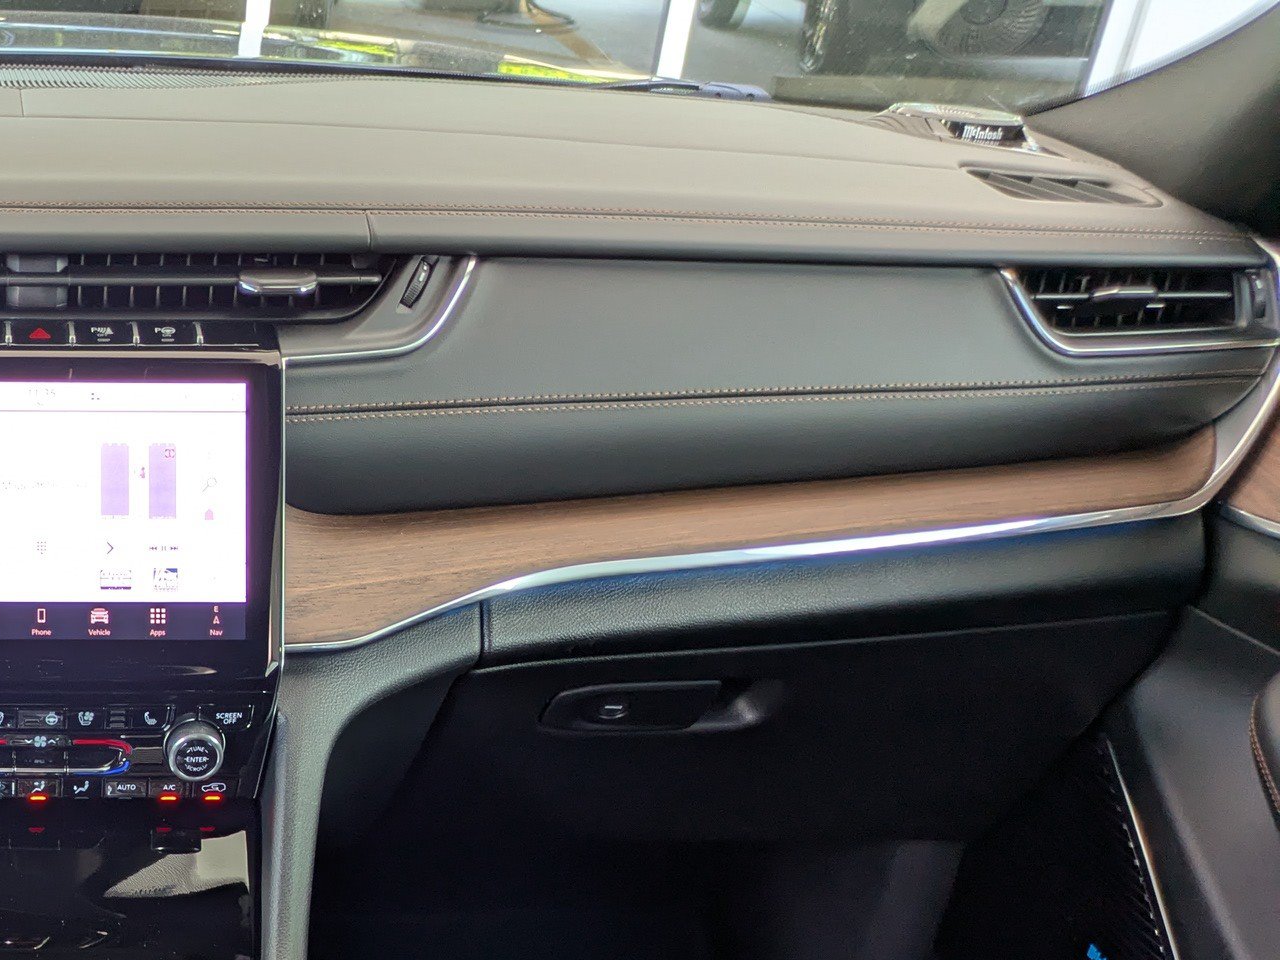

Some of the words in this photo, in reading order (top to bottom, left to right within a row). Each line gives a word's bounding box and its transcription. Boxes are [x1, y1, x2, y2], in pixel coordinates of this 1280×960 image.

[962, 124, 1003, 140] McIntosh
[31, 628, 52, 636] Phone
[88, 628, 111, 636] Vehicle
[149, 629, 166, 637] Apps
